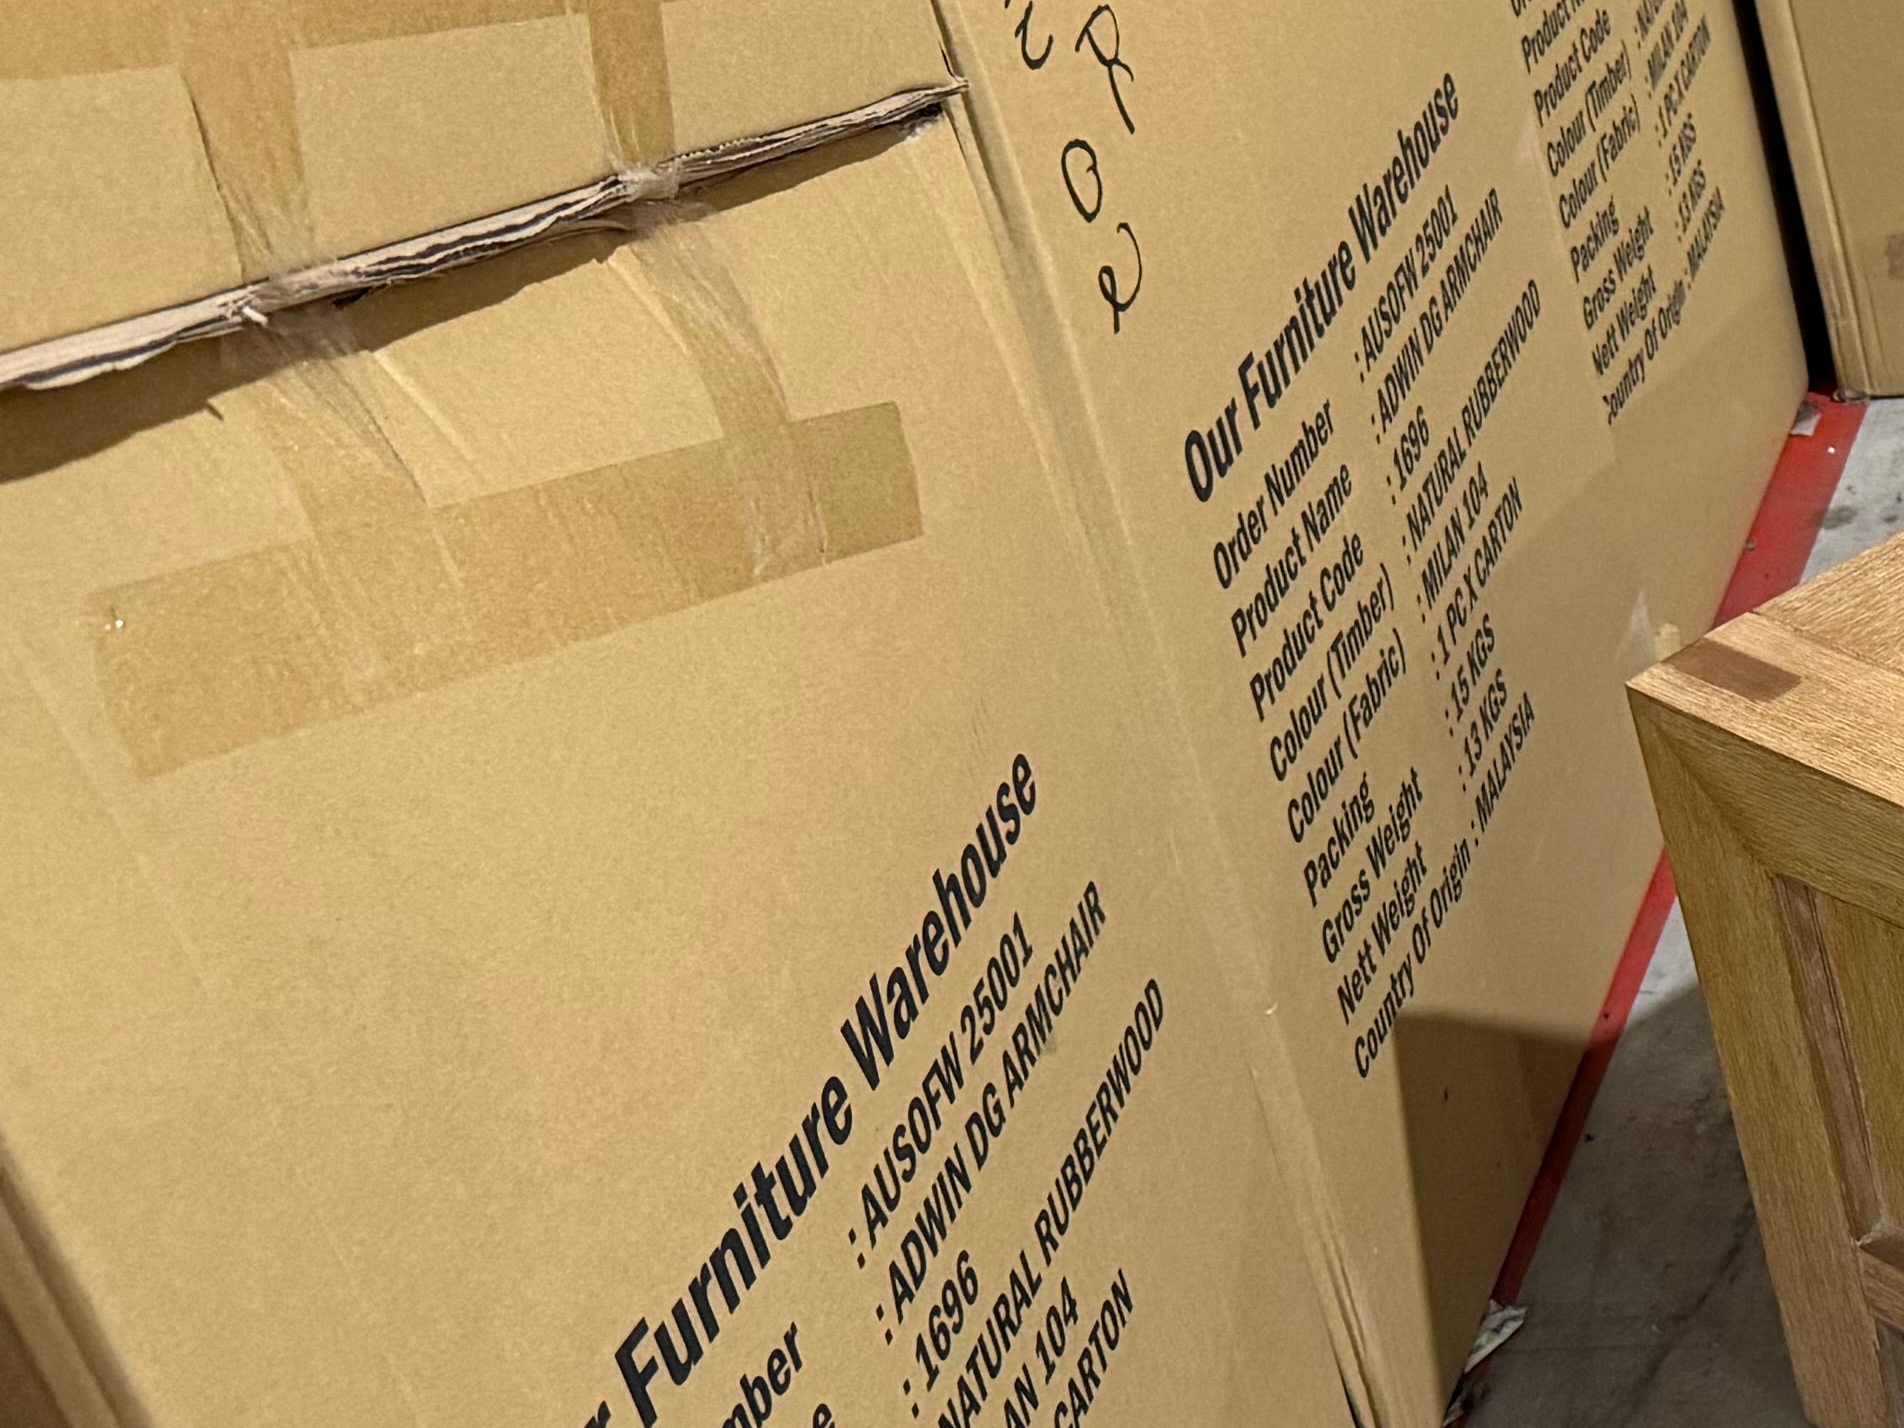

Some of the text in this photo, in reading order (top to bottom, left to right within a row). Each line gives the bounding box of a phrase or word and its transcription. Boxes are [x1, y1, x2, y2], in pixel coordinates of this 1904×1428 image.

[1533, 9, 1610, 127] Product Code
[1547, 40, 1631, 177] Colour (Timber)
[1558, 93, 1639, 228] Colour (Fabric)
[1182, 71, 1459, 504] Our Furniture Warehouse
[1211, 183, 1459, 590] Order Number AUSOFW 25001
[1570, 195, 1618, 283] Packing
[1583, 206, 1653, 330] Gross Weight
[1616, 265, 1656, 340] Weight
[1229, 186, 1504, 659] Product Name ADWIN DG ARMCHAIR
[1247, 403, 1430, 724] Product Code 1696
[1268, 277, 1541, 783] Colour (Timber) NATURAL RUBBERWOOD
[1285, 459, 1490, 844] Colour (Fabric) MILAN 104
[1301, 474, 1523, 909] Packing 1 PC X CARTON
[1320, 611, 1496, 964] Gross Weight 15 KGS
[838, 752, 1037, 1092] Warehouse
[1335, 666, 1508, 1027] Nett Weight 13 KGS
[1353, 690, 1536, 1079] Country Of Origin MALAYSIA
[859, 1029, 965, 1250] AUSOFW
[958, 910, 1034, 1066] 25001
[887, 1140, 973, 1326] ADWIN
[963, 1080, 1007, 1172] DG
[1000, 879, 1107, 1110] ARMCHAIR
[1032, 977, 1164, 1268] RUBBERWOOD
[914, 1248, 979, 1393] 1696
[1033, 1274, 1079, 1386] 104
